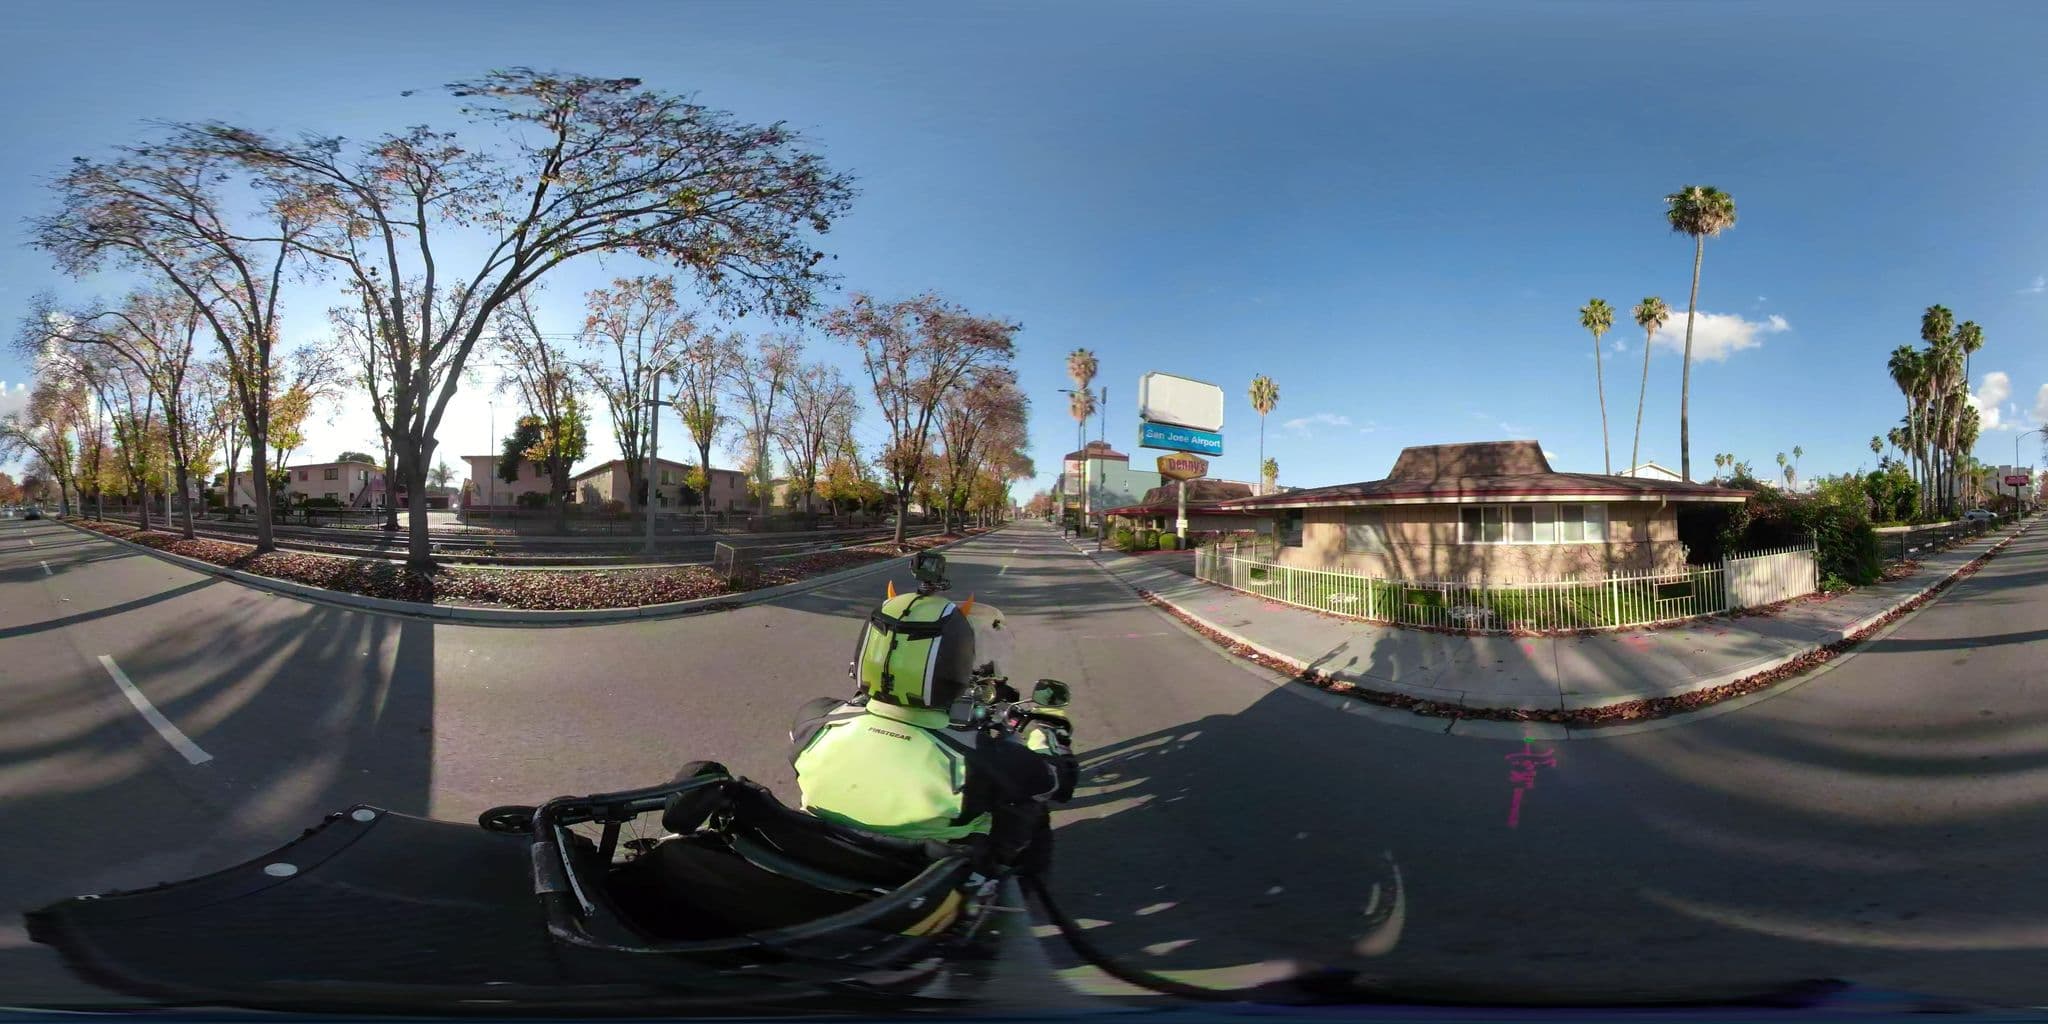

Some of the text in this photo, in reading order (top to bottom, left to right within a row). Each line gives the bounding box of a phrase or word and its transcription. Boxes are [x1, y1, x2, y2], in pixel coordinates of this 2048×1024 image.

[1146, 429, 1220, 448] San Jose Airport
[1169, 458, 1205, 473] Denny's
[868, 727, 912, 741] FIRSTGEAR
